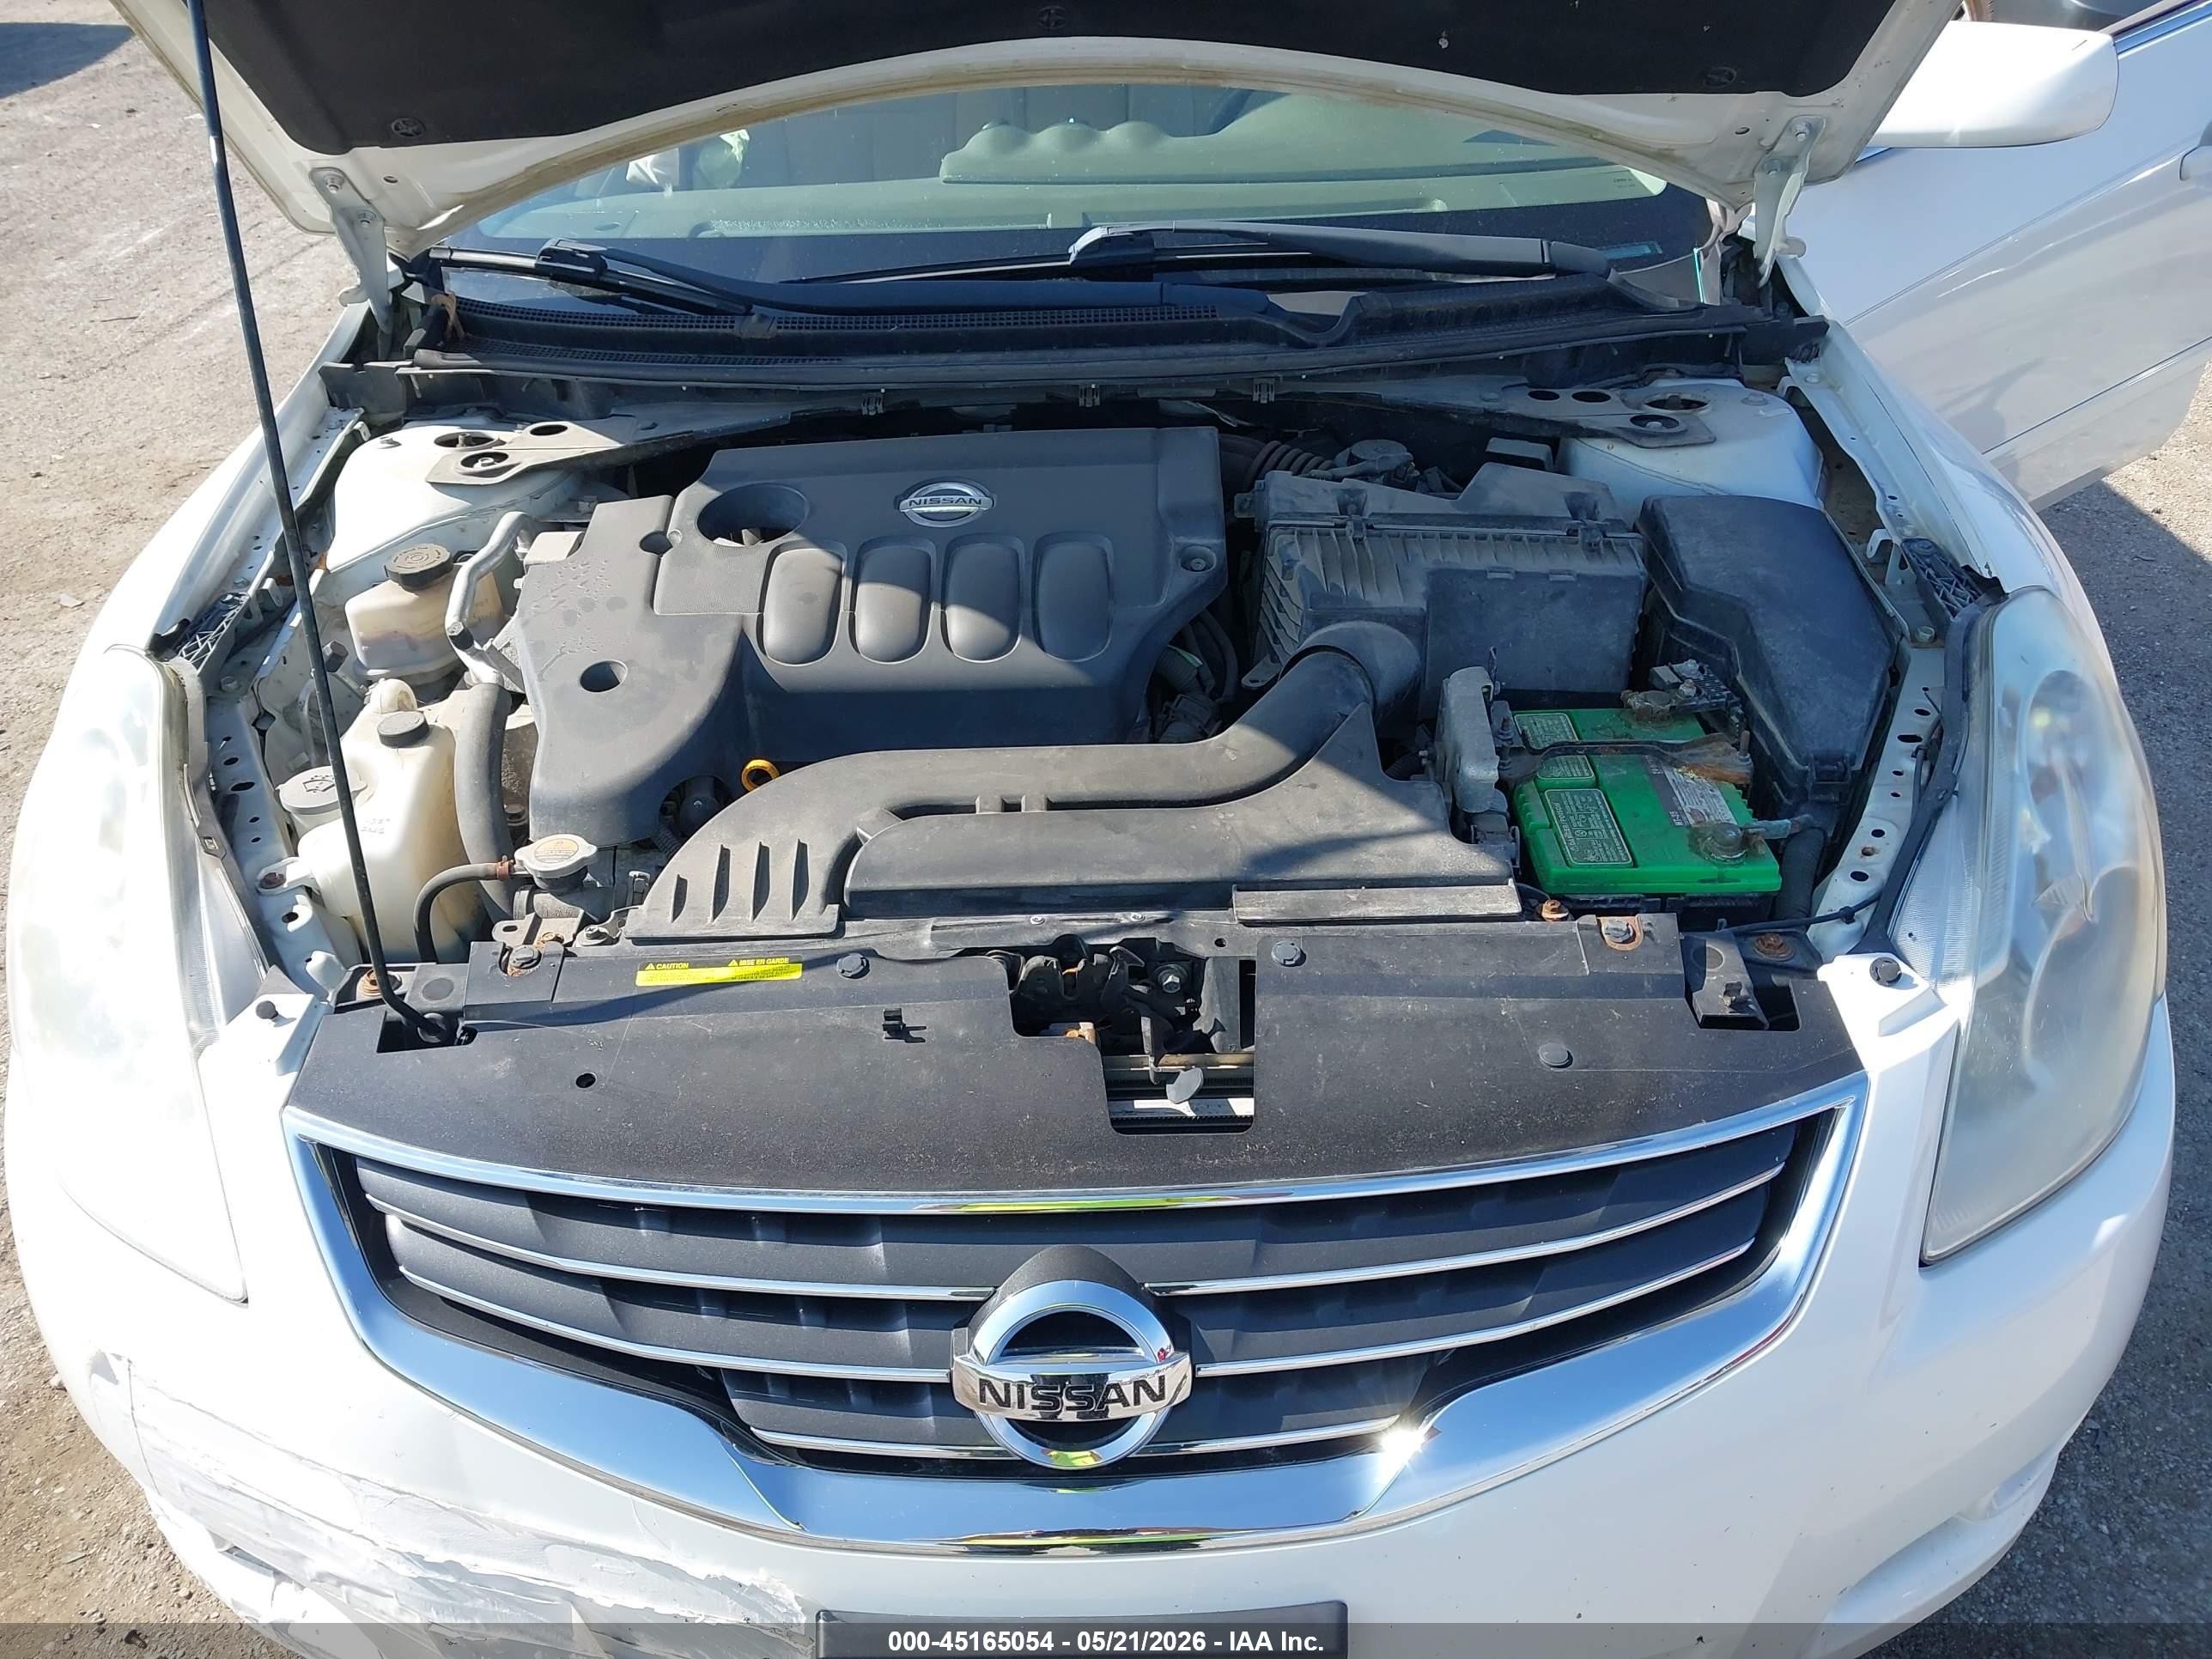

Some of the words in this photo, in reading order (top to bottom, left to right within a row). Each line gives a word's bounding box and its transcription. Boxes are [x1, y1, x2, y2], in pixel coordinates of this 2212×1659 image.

[908, 497, 982, 507] NISSAN
[655, 962, 690, 970] CAUTION
[738, 958, 755, 967] MISE
[766, 957, 789, 965] GARDE
[978, 1375, 1166, 1413] NISSAN
